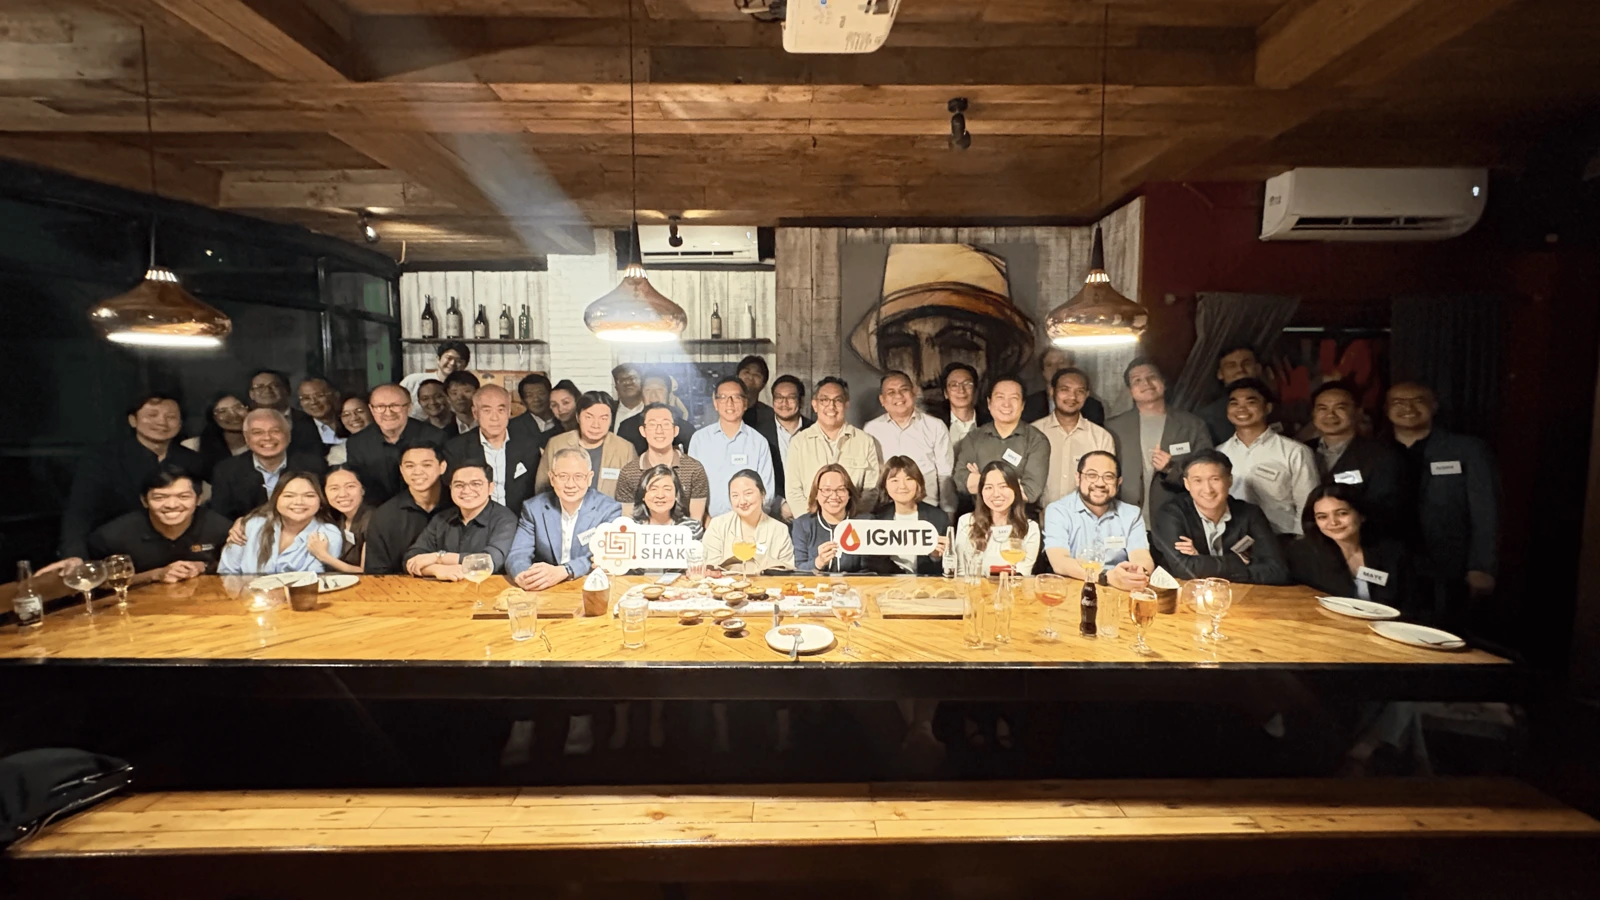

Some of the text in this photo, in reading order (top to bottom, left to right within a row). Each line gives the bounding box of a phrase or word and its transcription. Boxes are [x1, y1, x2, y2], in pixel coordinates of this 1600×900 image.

[641, 533, 684, 545] TECH
[866, 529, 933, 546] IGNITE
[1363, 571, 1382, 580] MAYE
